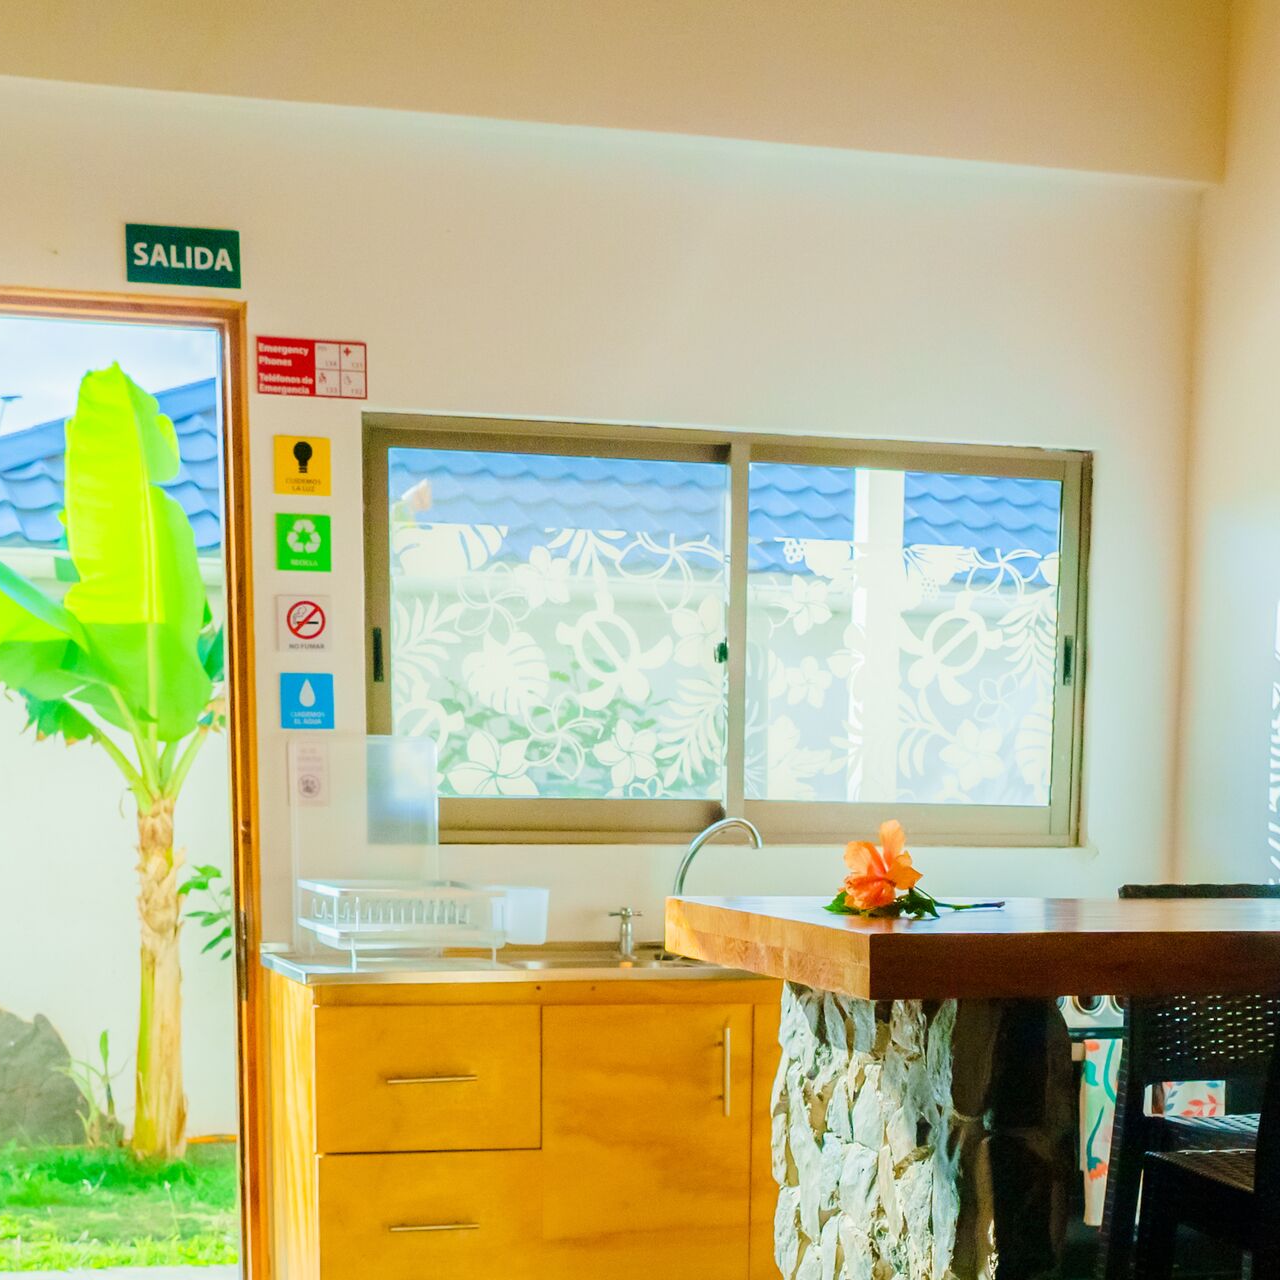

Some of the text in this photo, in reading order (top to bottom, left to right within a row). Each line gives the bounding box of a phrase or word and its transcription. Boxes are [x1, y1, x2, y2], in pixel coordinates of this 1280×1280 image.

[132, 241, 234, 272] SALIDA
[258, 342, 310, 357] Emergency
[258, 354, 293, 367] Phones
[302, 375, 314, 385] de
[258, 383, 311, 395] Emergencia
